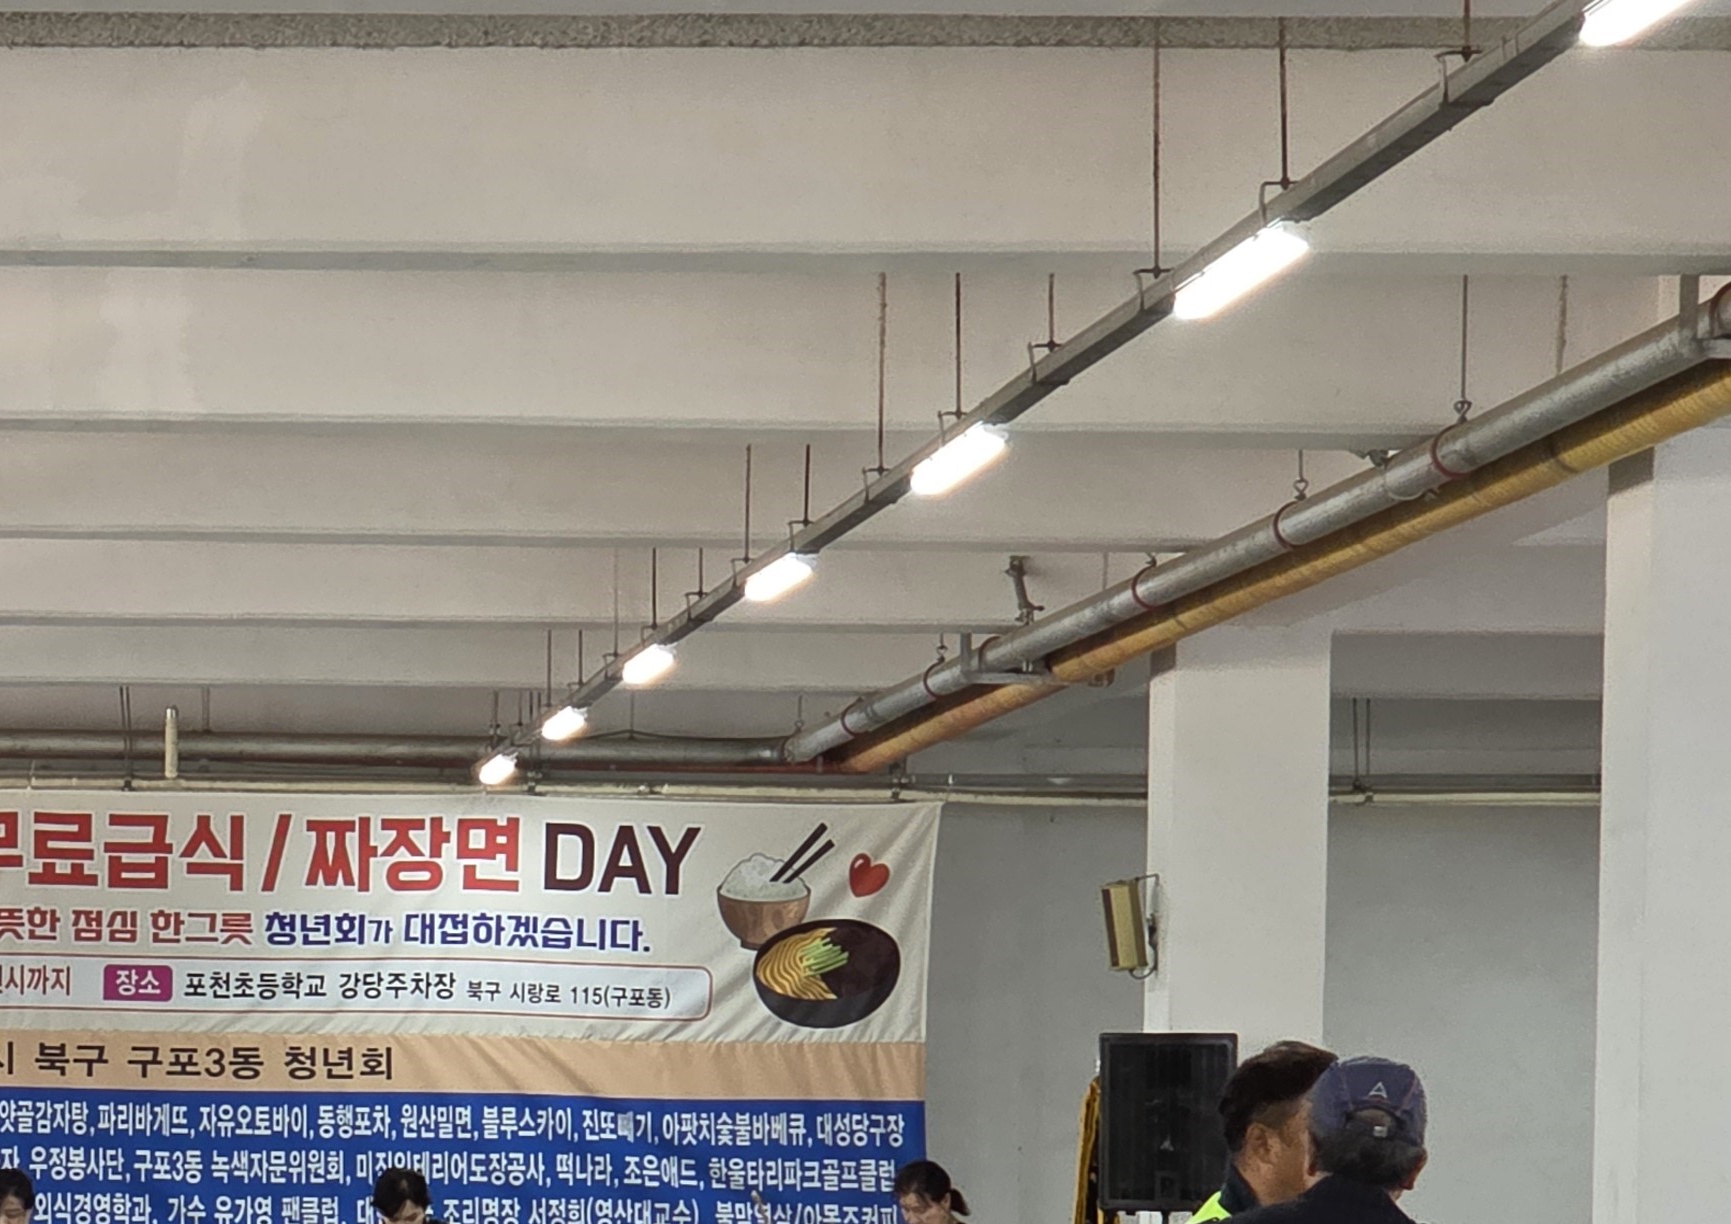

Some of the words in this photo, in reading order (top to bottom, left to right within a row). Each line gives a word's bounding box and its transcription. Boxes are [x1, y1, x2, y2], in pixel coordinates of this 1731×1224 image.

[543, 820, 705, 896] DAY
[71, 909, 138, 943] 점심
[149, 909, 254, 945] 한그릇
[264, 911, 394, 946] 청년회가
[403, 912, 651, 953] 대접하겠습니다.
[118, 971, 159, 995] 장소
[183, 970, 327, 1001] 포천초등학교
[338, 971, 457, 1001] 강당주차장
[467, 980, 502, 1002] 북구
[509, 982, 562, 1004] 시랑로
[571, 985, 671, 1009] 115(구포동)
[34, 1042, 109, 1078] 북구
[126, 1045, 265, 1080] 구포3동
[283, 1045, 393, 1081] 청년회
[97, 1102, 195, 1138] 파리바게뜨,
[199, 1104, 314, 1139] 자유오토바이,
[317, 1104, 397, 1140] 동행포차,
[400, 1104, 479, 1140] 원산밀면,
[481, 1106, 579, 1141] 블루스카이,
[816, 1113, 905, 1147] 대성당구장
[29, 1146, 131, 1182] 우정봉사단,
[133, 1149, 203, 1184] 구포3동
[211, 1149, 351, 1186] 녹색자문위원회,
[556, 1152, 619, 1186] 떡나라,
[623, 1154, 704, 1190] 조은애드,
